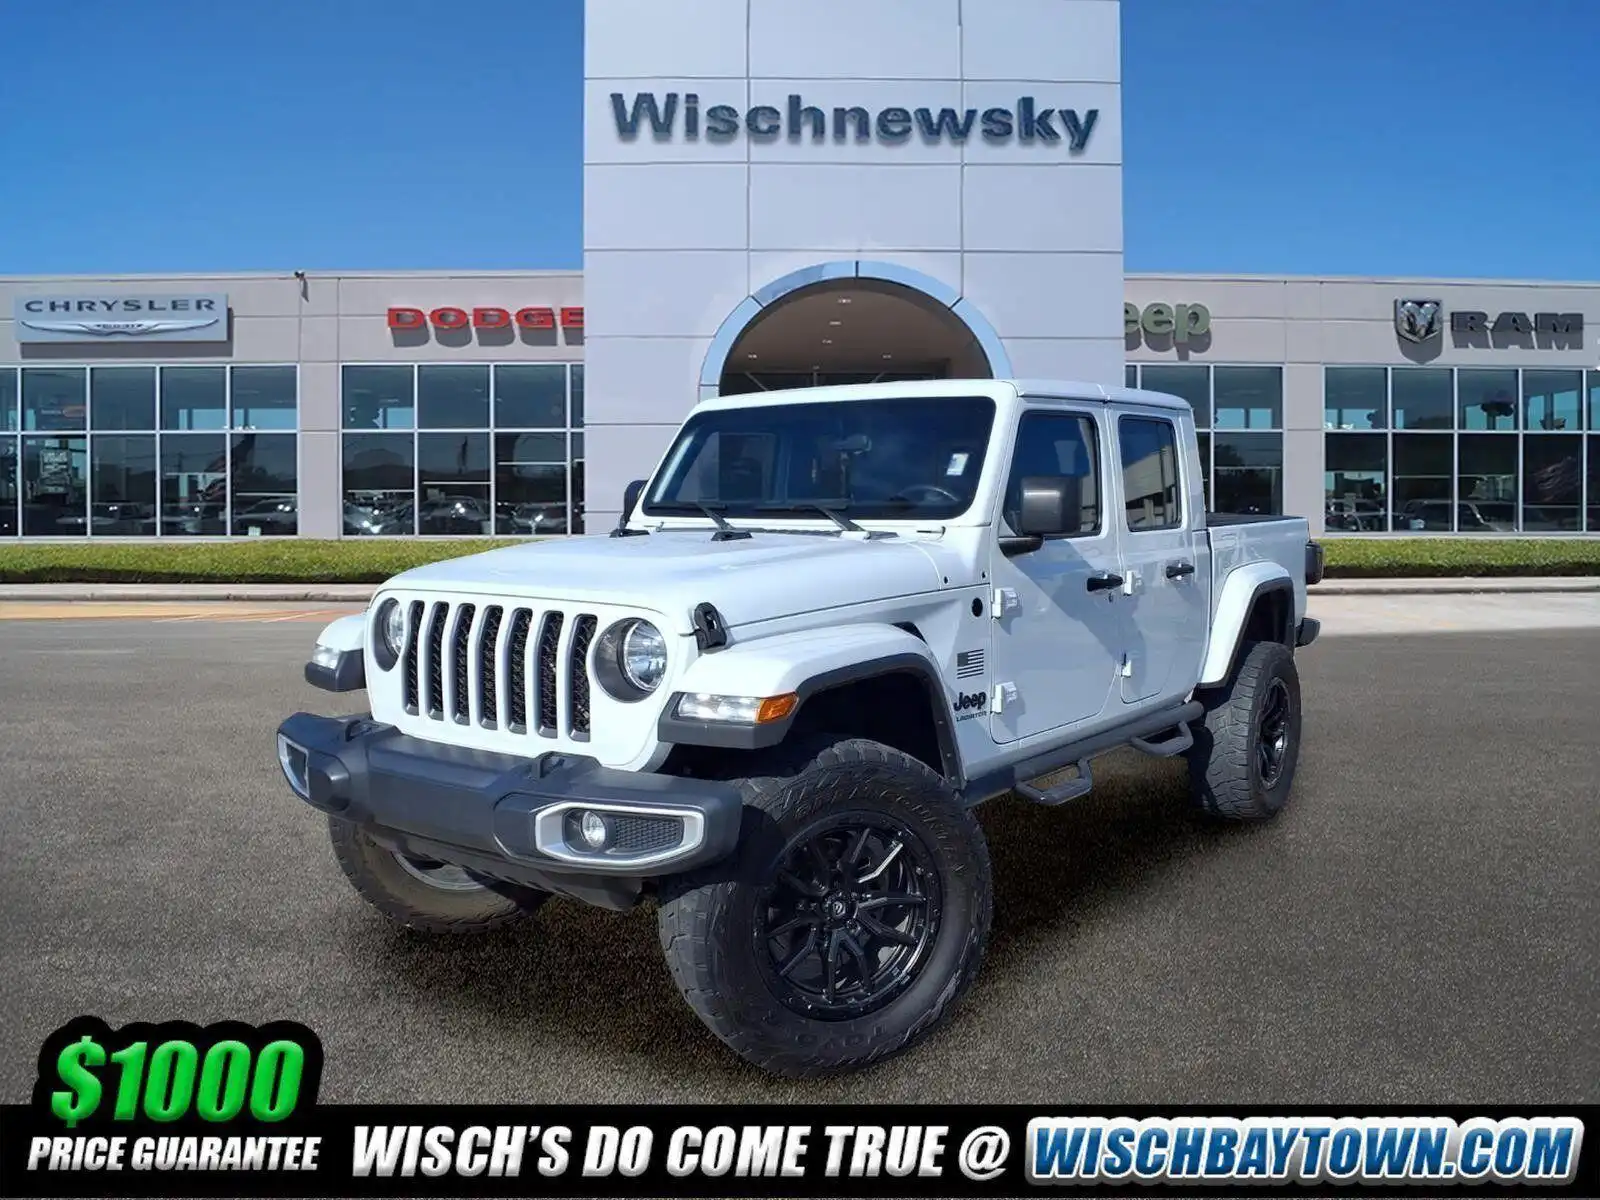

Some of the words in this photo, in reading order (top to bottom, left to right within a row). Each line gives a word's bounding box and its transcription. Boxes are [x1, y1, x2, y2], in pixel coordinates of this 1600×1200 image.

[609, 91, 1100, 155] Wischnewsky
[24, 299, 216, 313] CHRYSLER
[387, 306, 584, 329] DODGE
[1450, 311, 1584, 334] RAM
[953, 691, 987, 711] Jeep
